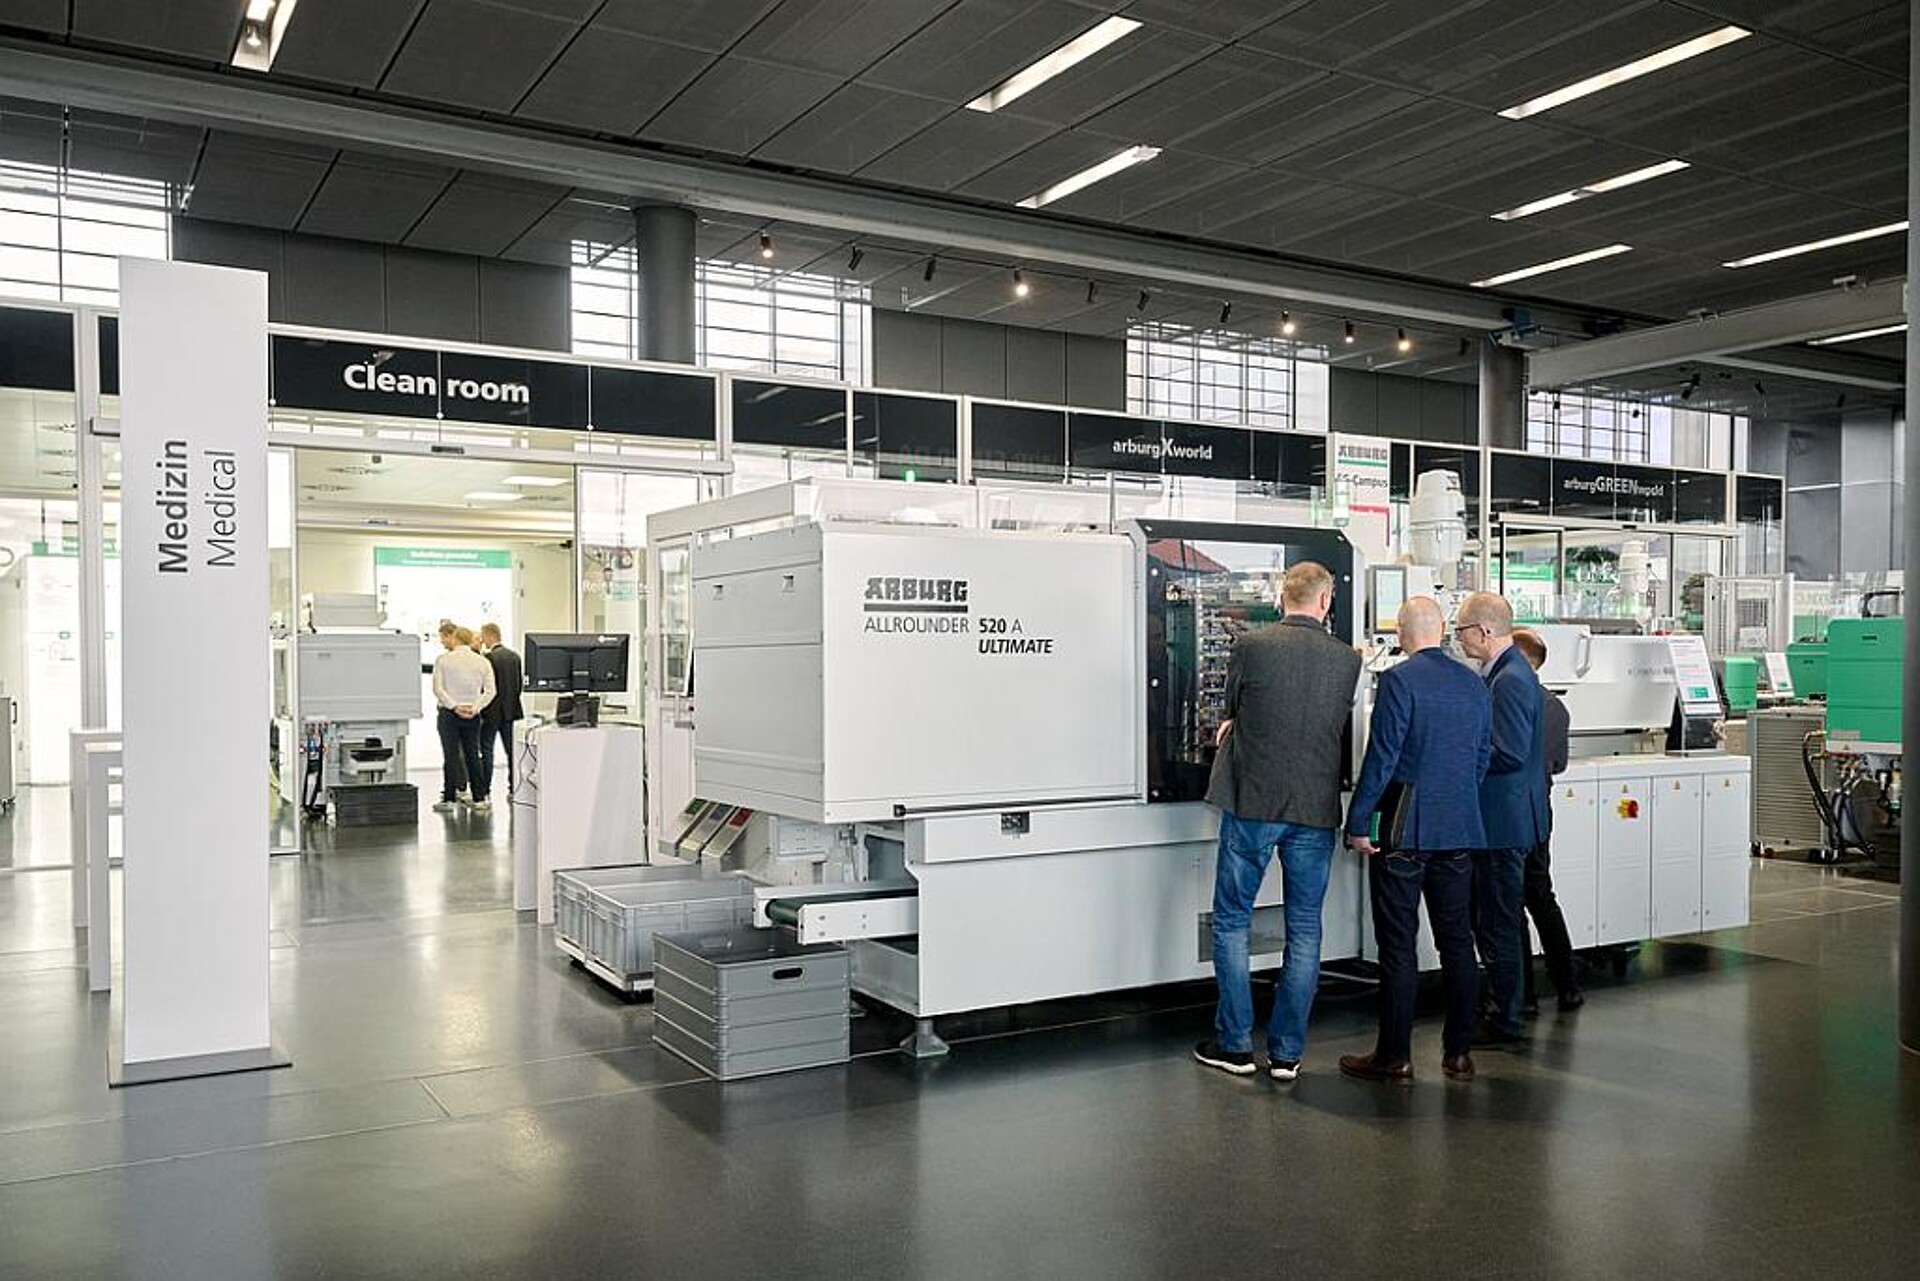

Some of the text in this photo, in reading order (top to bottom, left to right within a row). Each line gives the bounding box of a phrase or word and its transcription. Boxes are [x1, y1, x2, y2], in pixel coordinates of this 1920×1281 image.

[343, 364, 530, 404] Clean room
[1112, 438, 1212, 460] arburgXworld
[156, 440, 188, 573] Medizin
[204, 450, 236, 567] Medical
[864, 577, 968, 602] ARBURG
[864, 616, 1023, 634] ALLROUNDER 520 A
[978, 639, 1054, 654] ULTIMATE
